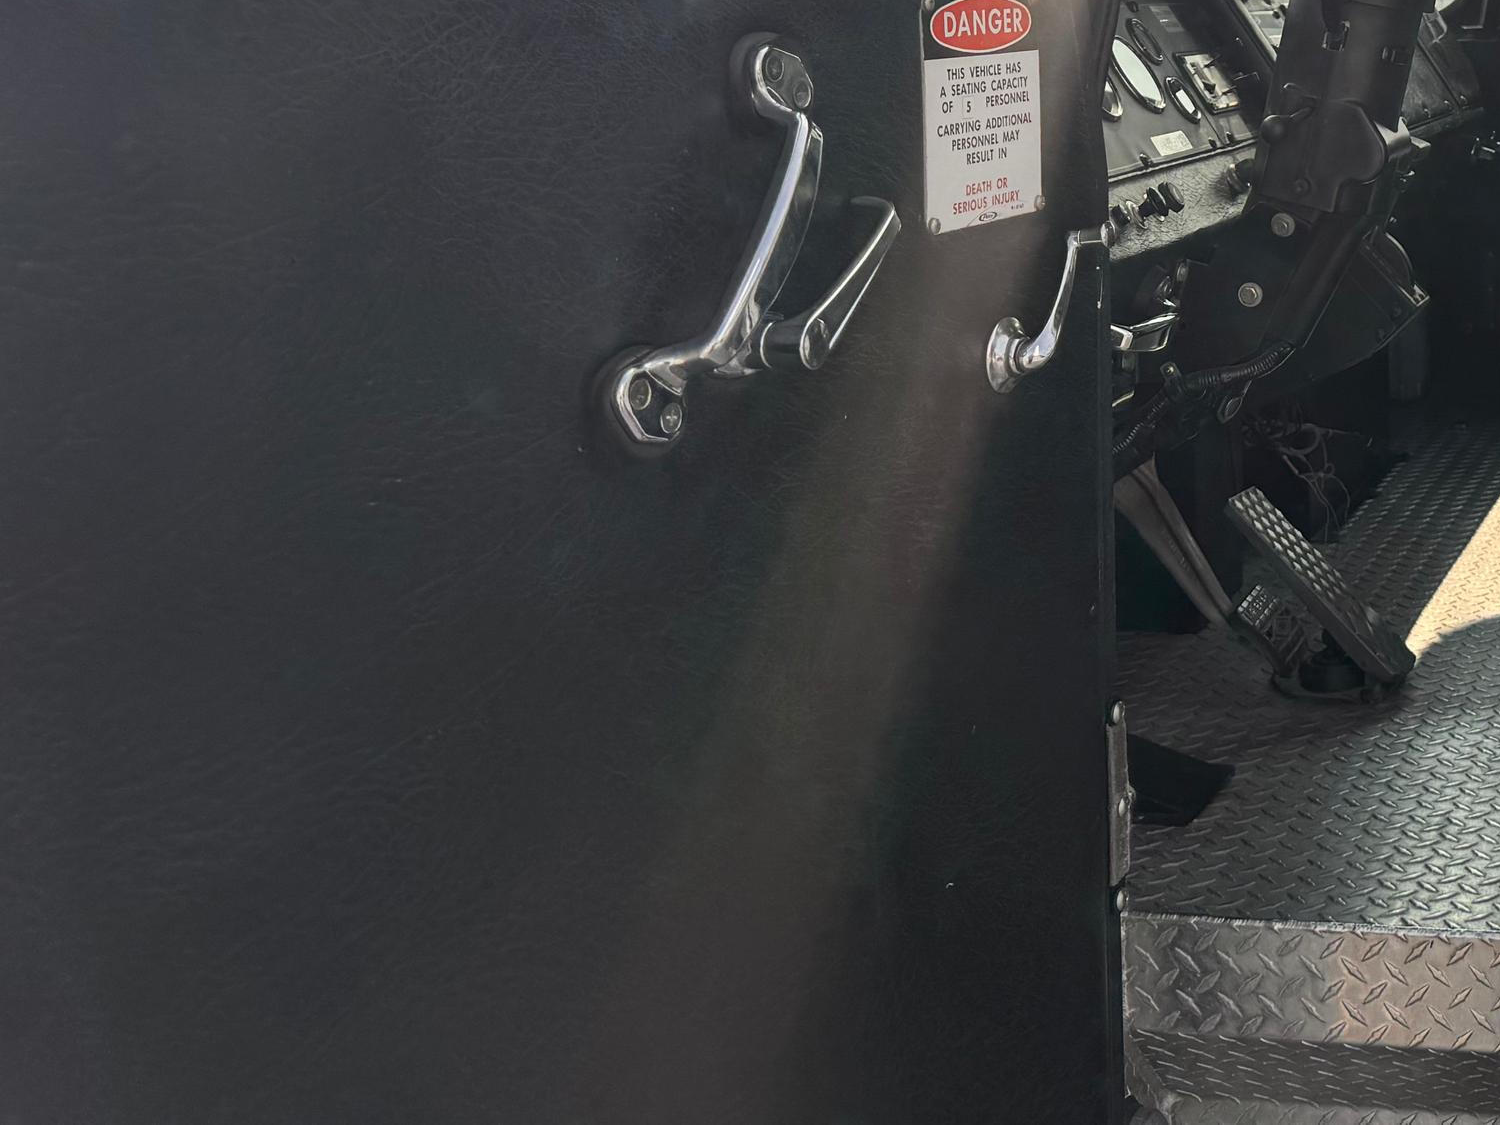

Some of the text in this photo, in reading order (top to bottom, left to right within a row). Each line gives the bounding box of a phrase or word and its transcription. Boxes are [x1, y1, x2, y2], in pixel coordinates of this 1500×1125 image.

[943, 7, 1023, 38] DANGER
[947, 61, 1021, 81] THIS VEHICLE HAS
[940, 76, 1028, 98] A SEATING CAPACITY
[942, 91, 1029, 114] OF 5 PERSONNEL
[937, 112, 1032, 138] CARRYING ADDITIONAL
[952, 129, 1020, 151] PERSONNEL MAY
[966, 147, 1007, 165] RESULT IN
[966, 177, 1008, 196] DEATH OR
[953, 190, 1020, 215] SERIOUS INJURY
